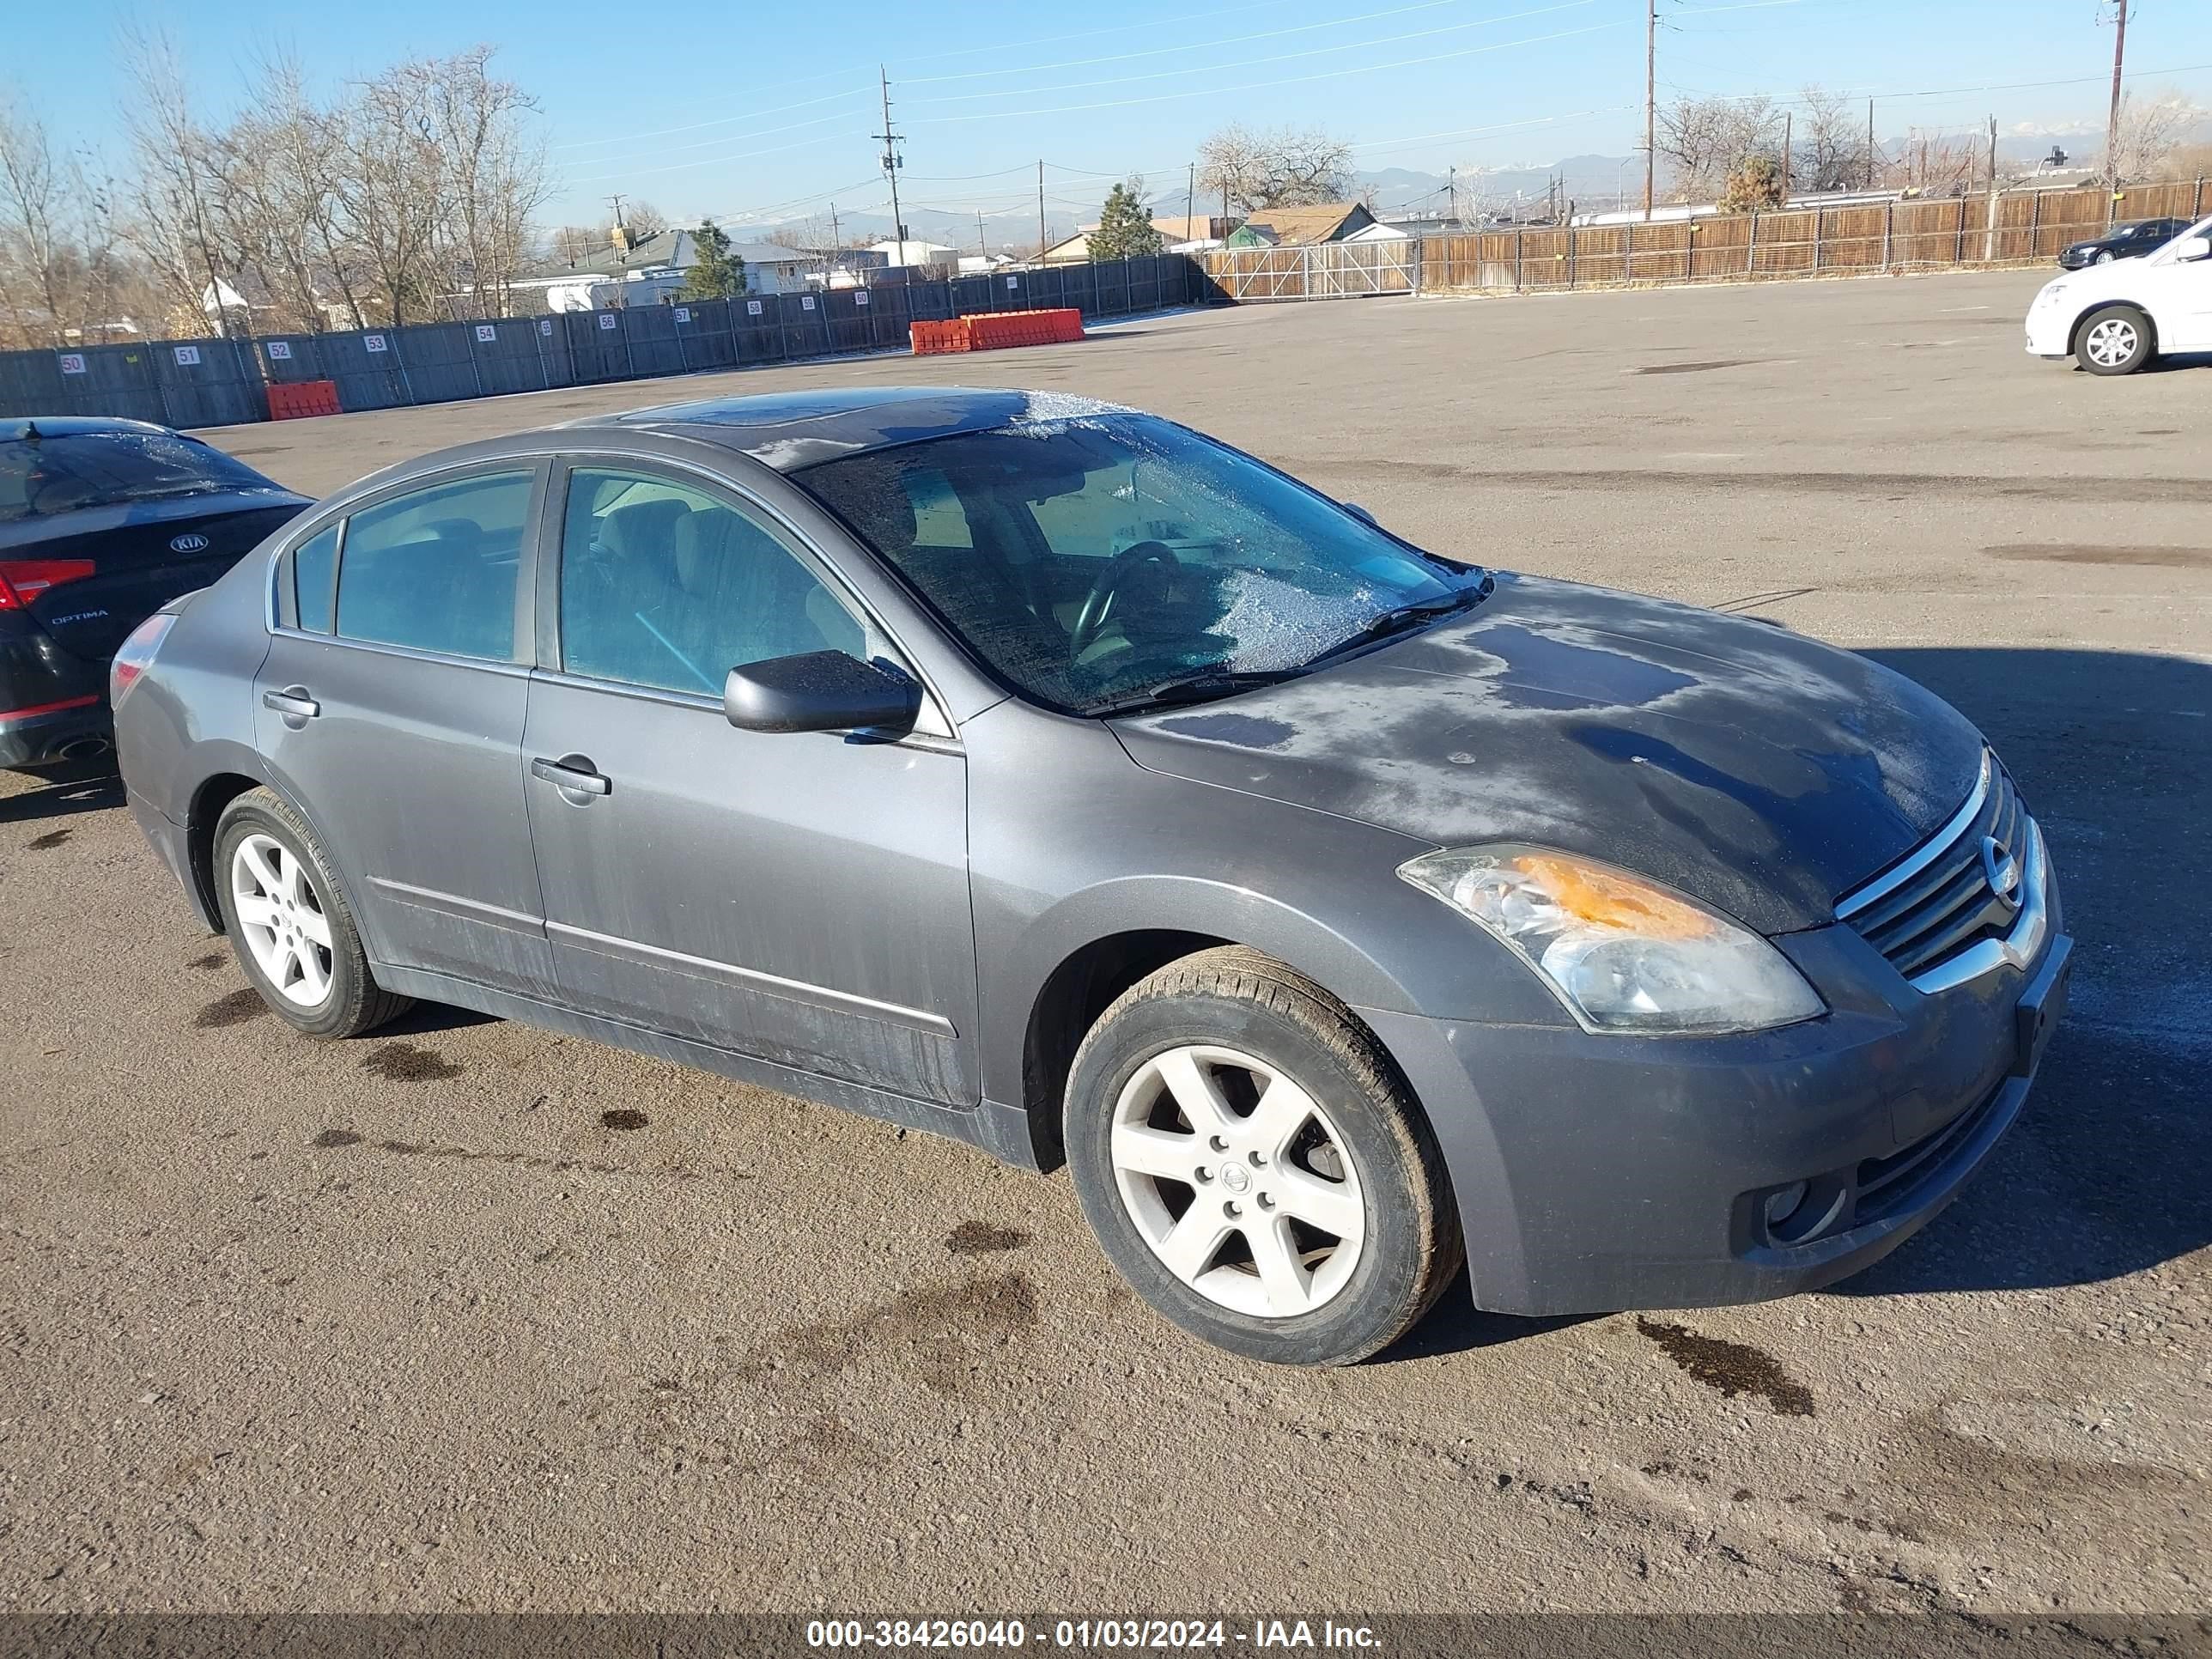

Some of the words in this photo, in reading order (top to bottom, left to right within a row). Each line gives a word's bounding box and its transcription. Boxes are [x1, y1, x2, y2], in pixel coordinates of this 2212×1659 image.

[805, 299, 813, 307] 59
[858, 294, 866, 303] 60
[750, 303, 760, 313] 58
[676, 310, 687, 320] 57
[603, 317, 613, 327] 56
[480, 328, 493, 340] 54
[542, 323, 550, 334] 55
[368, 337, 383, 349] 53
[179, 350, 194, 362] 51
[272, 345, 288, 357] 52
[63, 357, 80, 370] 50
[177, 537, 204, 550] KIA
[52, 610, 108, 625] OPTIMA
